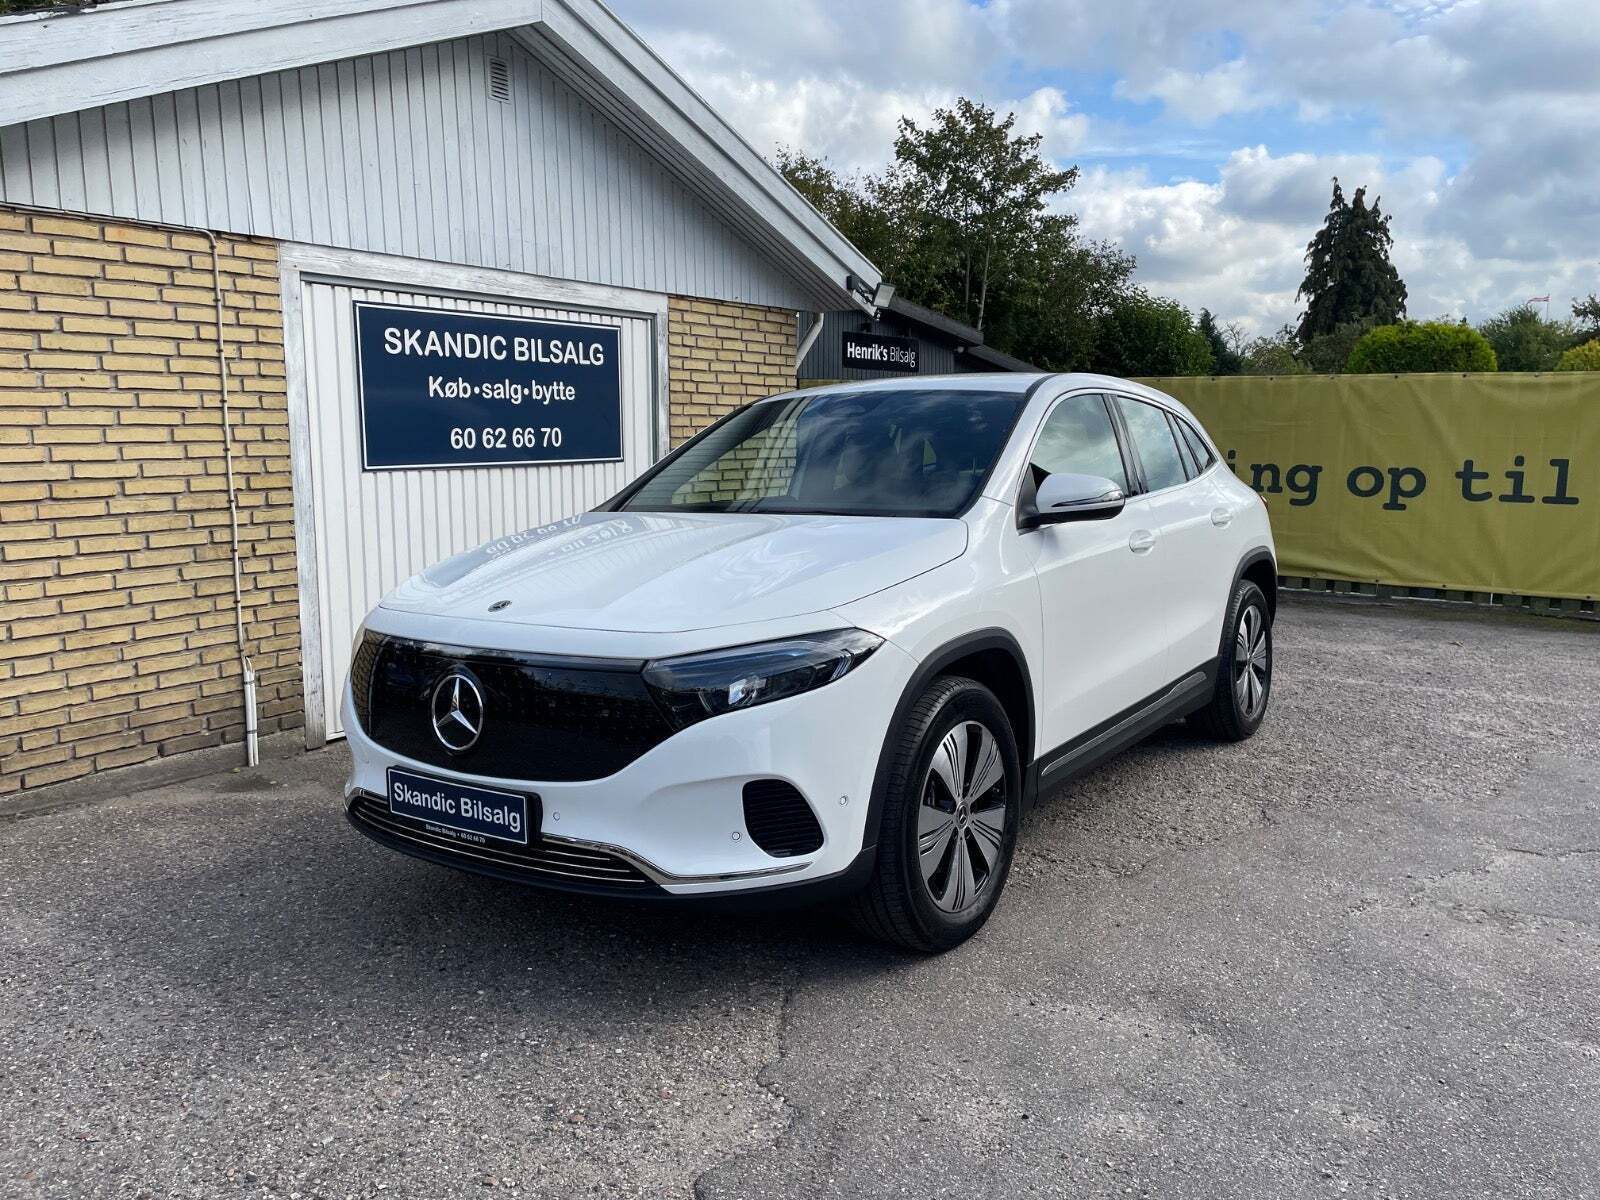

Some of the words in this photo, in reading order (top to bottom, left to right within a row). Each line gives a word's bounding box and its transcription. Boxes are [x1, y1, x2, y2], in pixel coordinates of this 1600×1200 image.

[384, 327, 507, 361] SKANDIC
[513, 337, 604, 366] BILSALG
[847, 341, 888, 361] Henrik's
[889, 346, 916, 368] Bilsalg
[450, 428, 476, 449] 60
[482, 428, 507, 448] 62
[512, 428, 535, 448] 66
[540, 427, 562, 447] 70
[1226, 449, 1323, 506] ng
[1346, 465, 1427, 511] op
[1455, 455, 1580, 505] til
[393, 782, 456, 814] Skandic
[460, 797, 521, 833] Bilsalg
